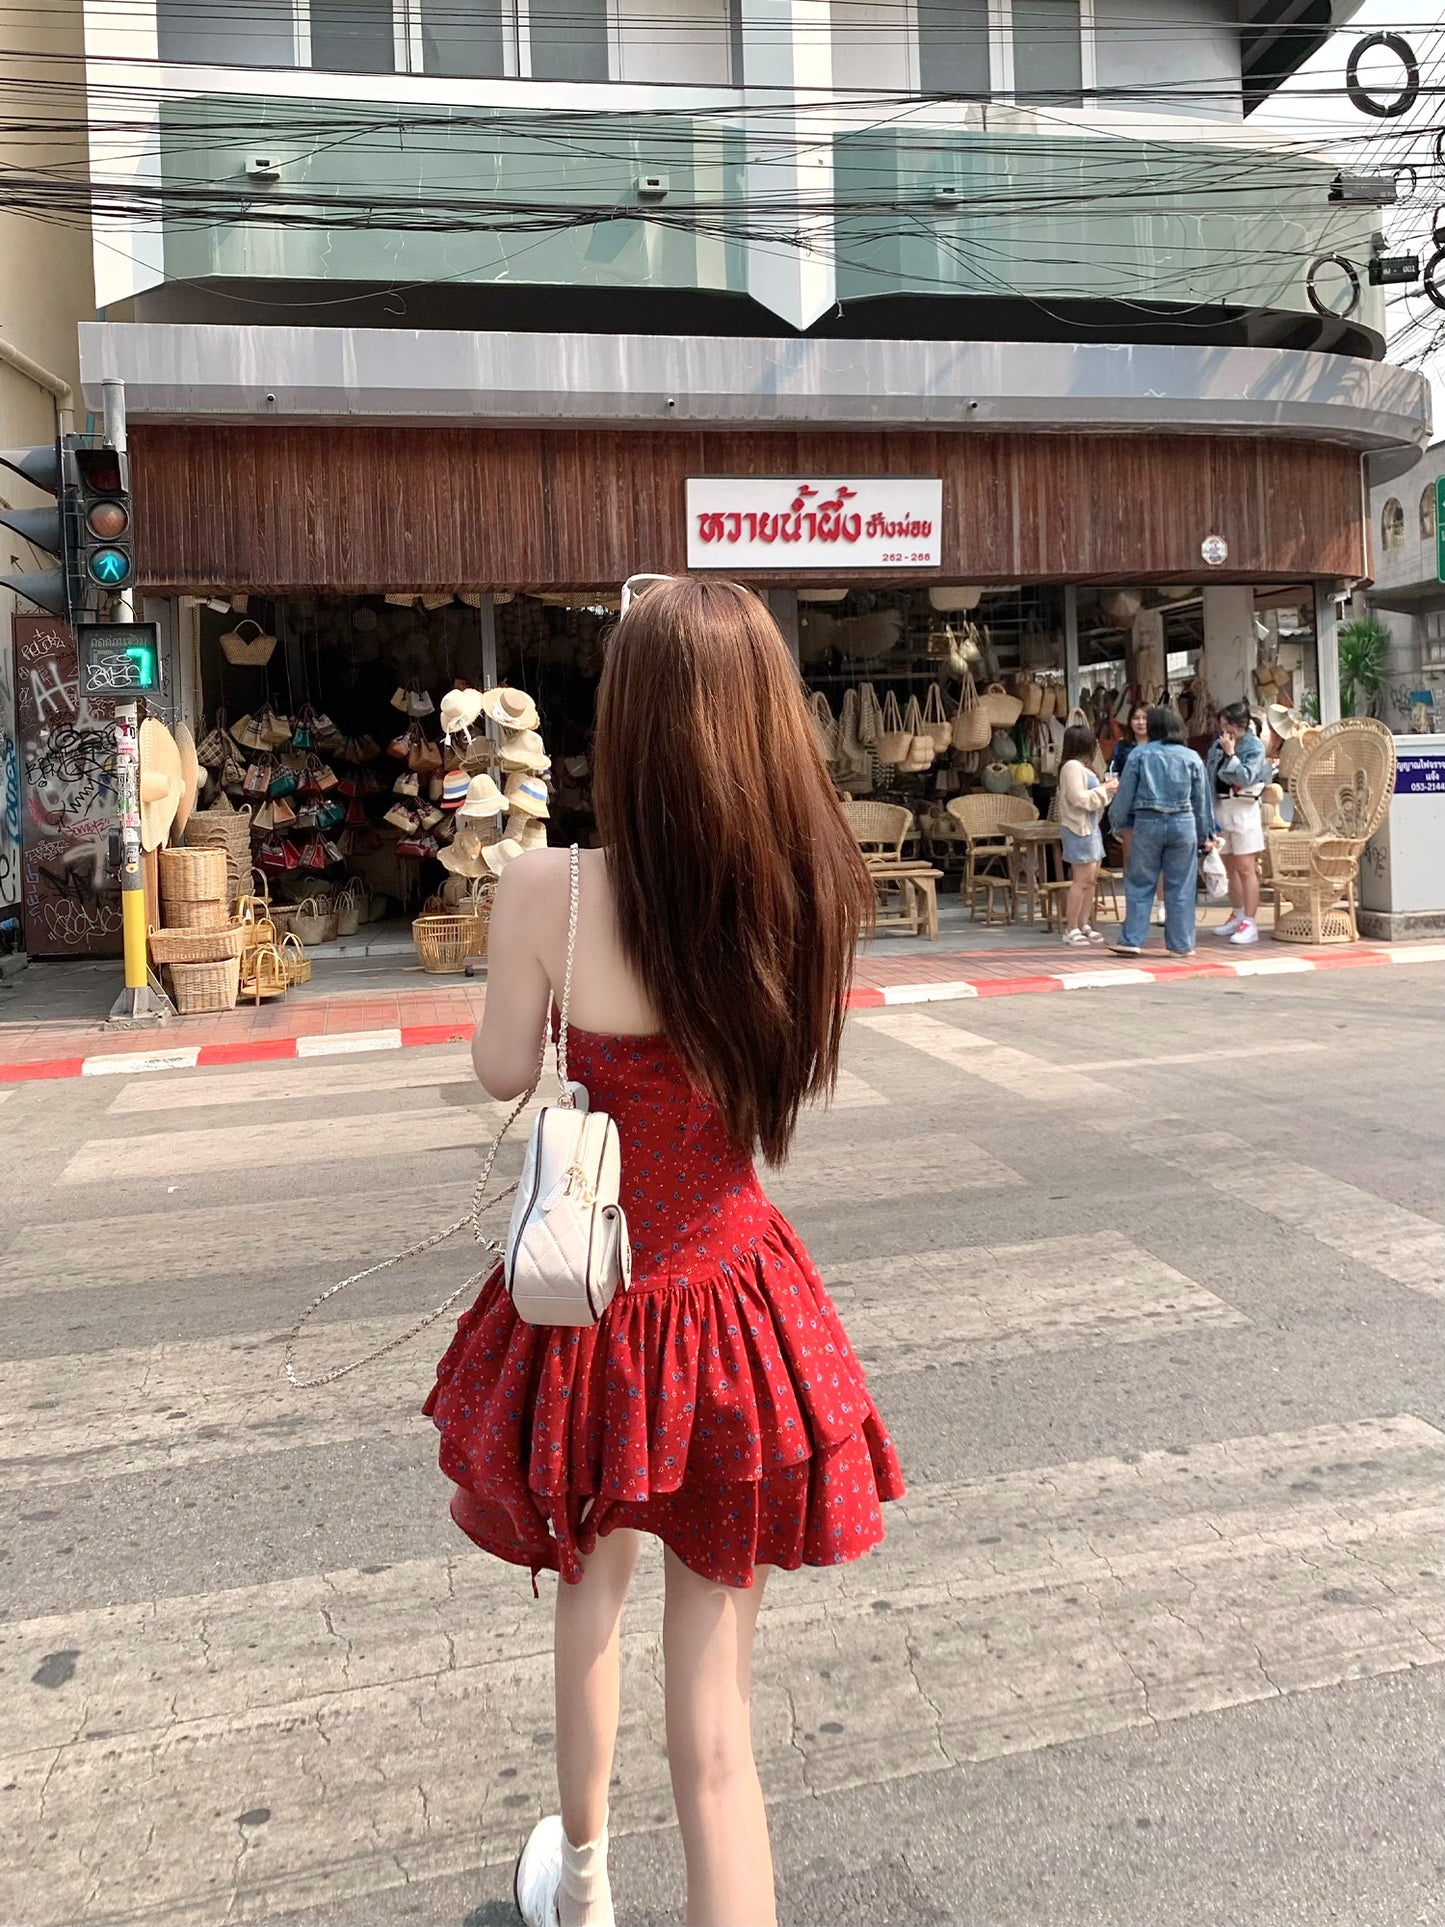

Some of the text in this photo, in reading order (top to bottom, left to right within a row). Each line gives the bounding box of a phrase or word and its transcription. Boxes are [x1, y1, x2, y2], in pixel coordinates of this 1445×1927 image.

[696, 484, 932, 544] หวายน้ำผึ้ง ช้างม่อย
[881, 553, 903, 562] 262
